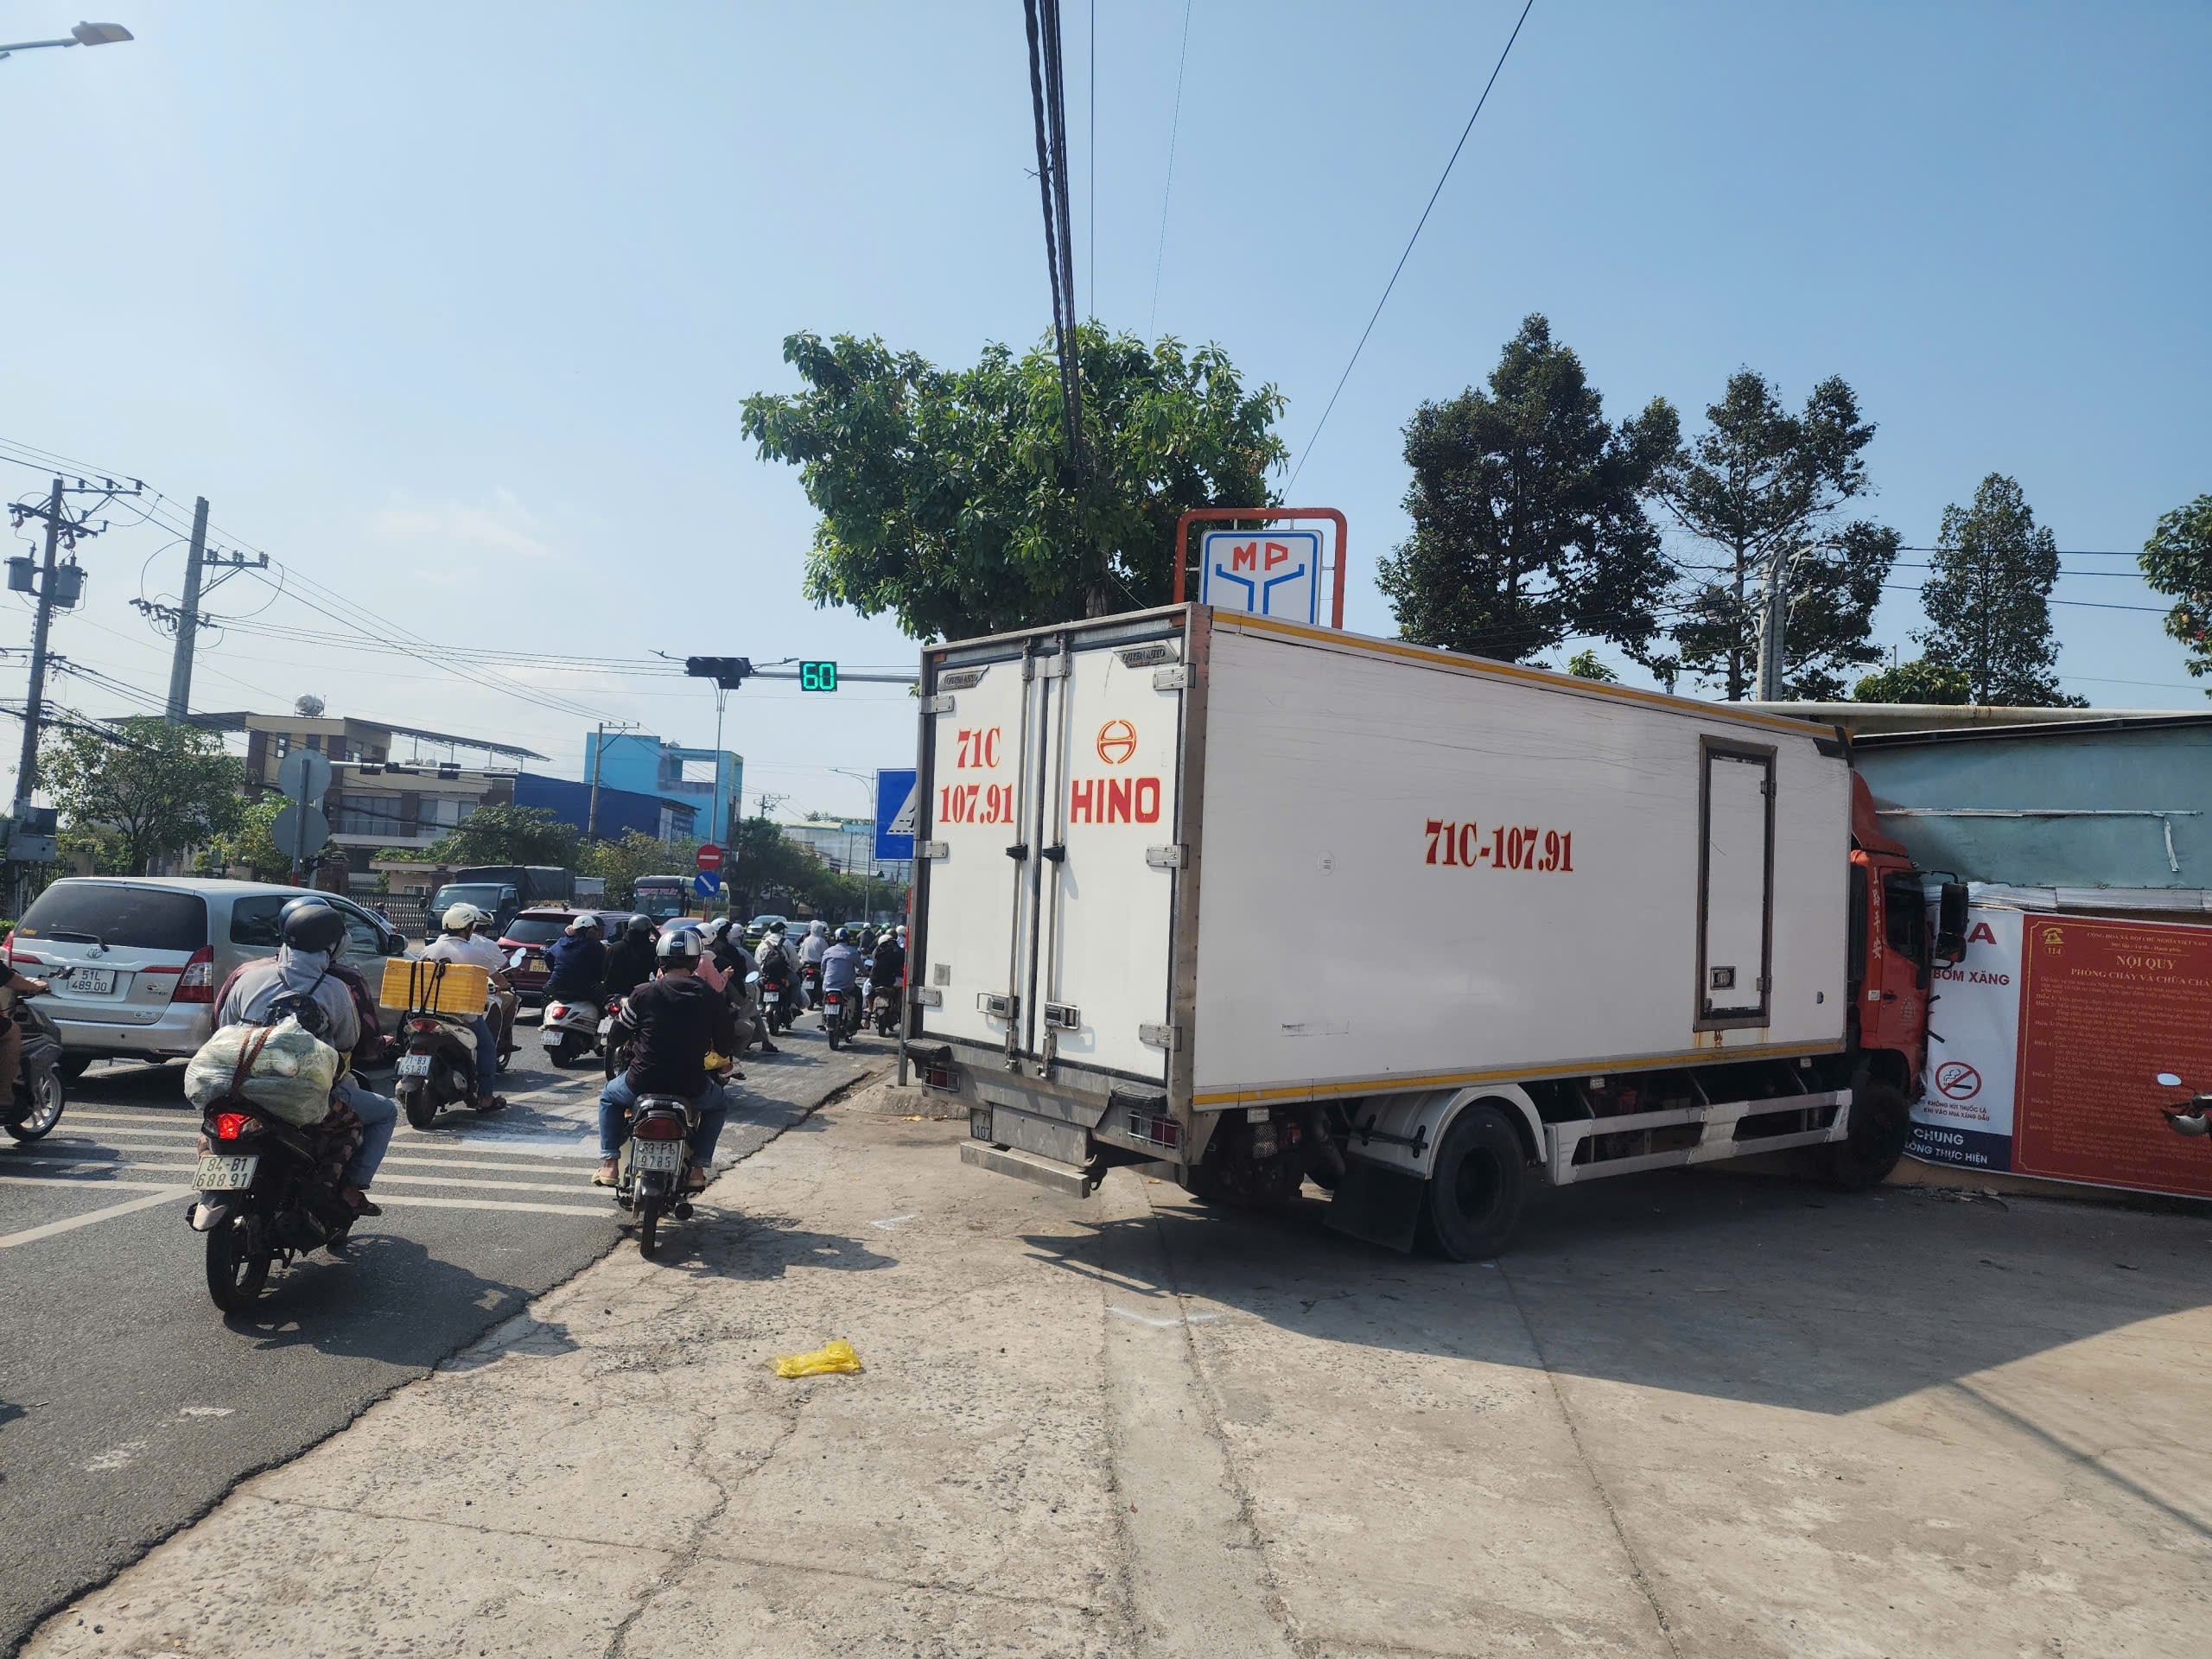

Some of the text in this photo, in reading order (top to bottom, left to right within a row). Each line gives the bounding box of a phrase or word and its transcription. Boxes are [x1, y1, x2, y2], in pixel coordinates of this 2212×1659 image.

[802, 663, 835, 690] 60
[957, 725, 1001, 768] 71C
[938, 783, 1014, 823] 107.91
[1071, 777, 1160, 823] HINO
[1426, 818, 1573, 872] 71C-107.91
[2116, 955, 2177, 970] NỘI QUY
[82, 969, 100, 981] 51L
[1968, 970, 2010, 985] XĂNG
[2070, 967, 2107, 978] PHÒNG
[2188, 976, 2212, 987] CHÁ
[72, 980, 107, 992] 489.00
[1913, 1128, 1964, 1145] CHUNG
[1904, 1140, 1988, 1165] LÒNG THỰC HIỆN
[207, 1158, 248, 1172] 84-B1
